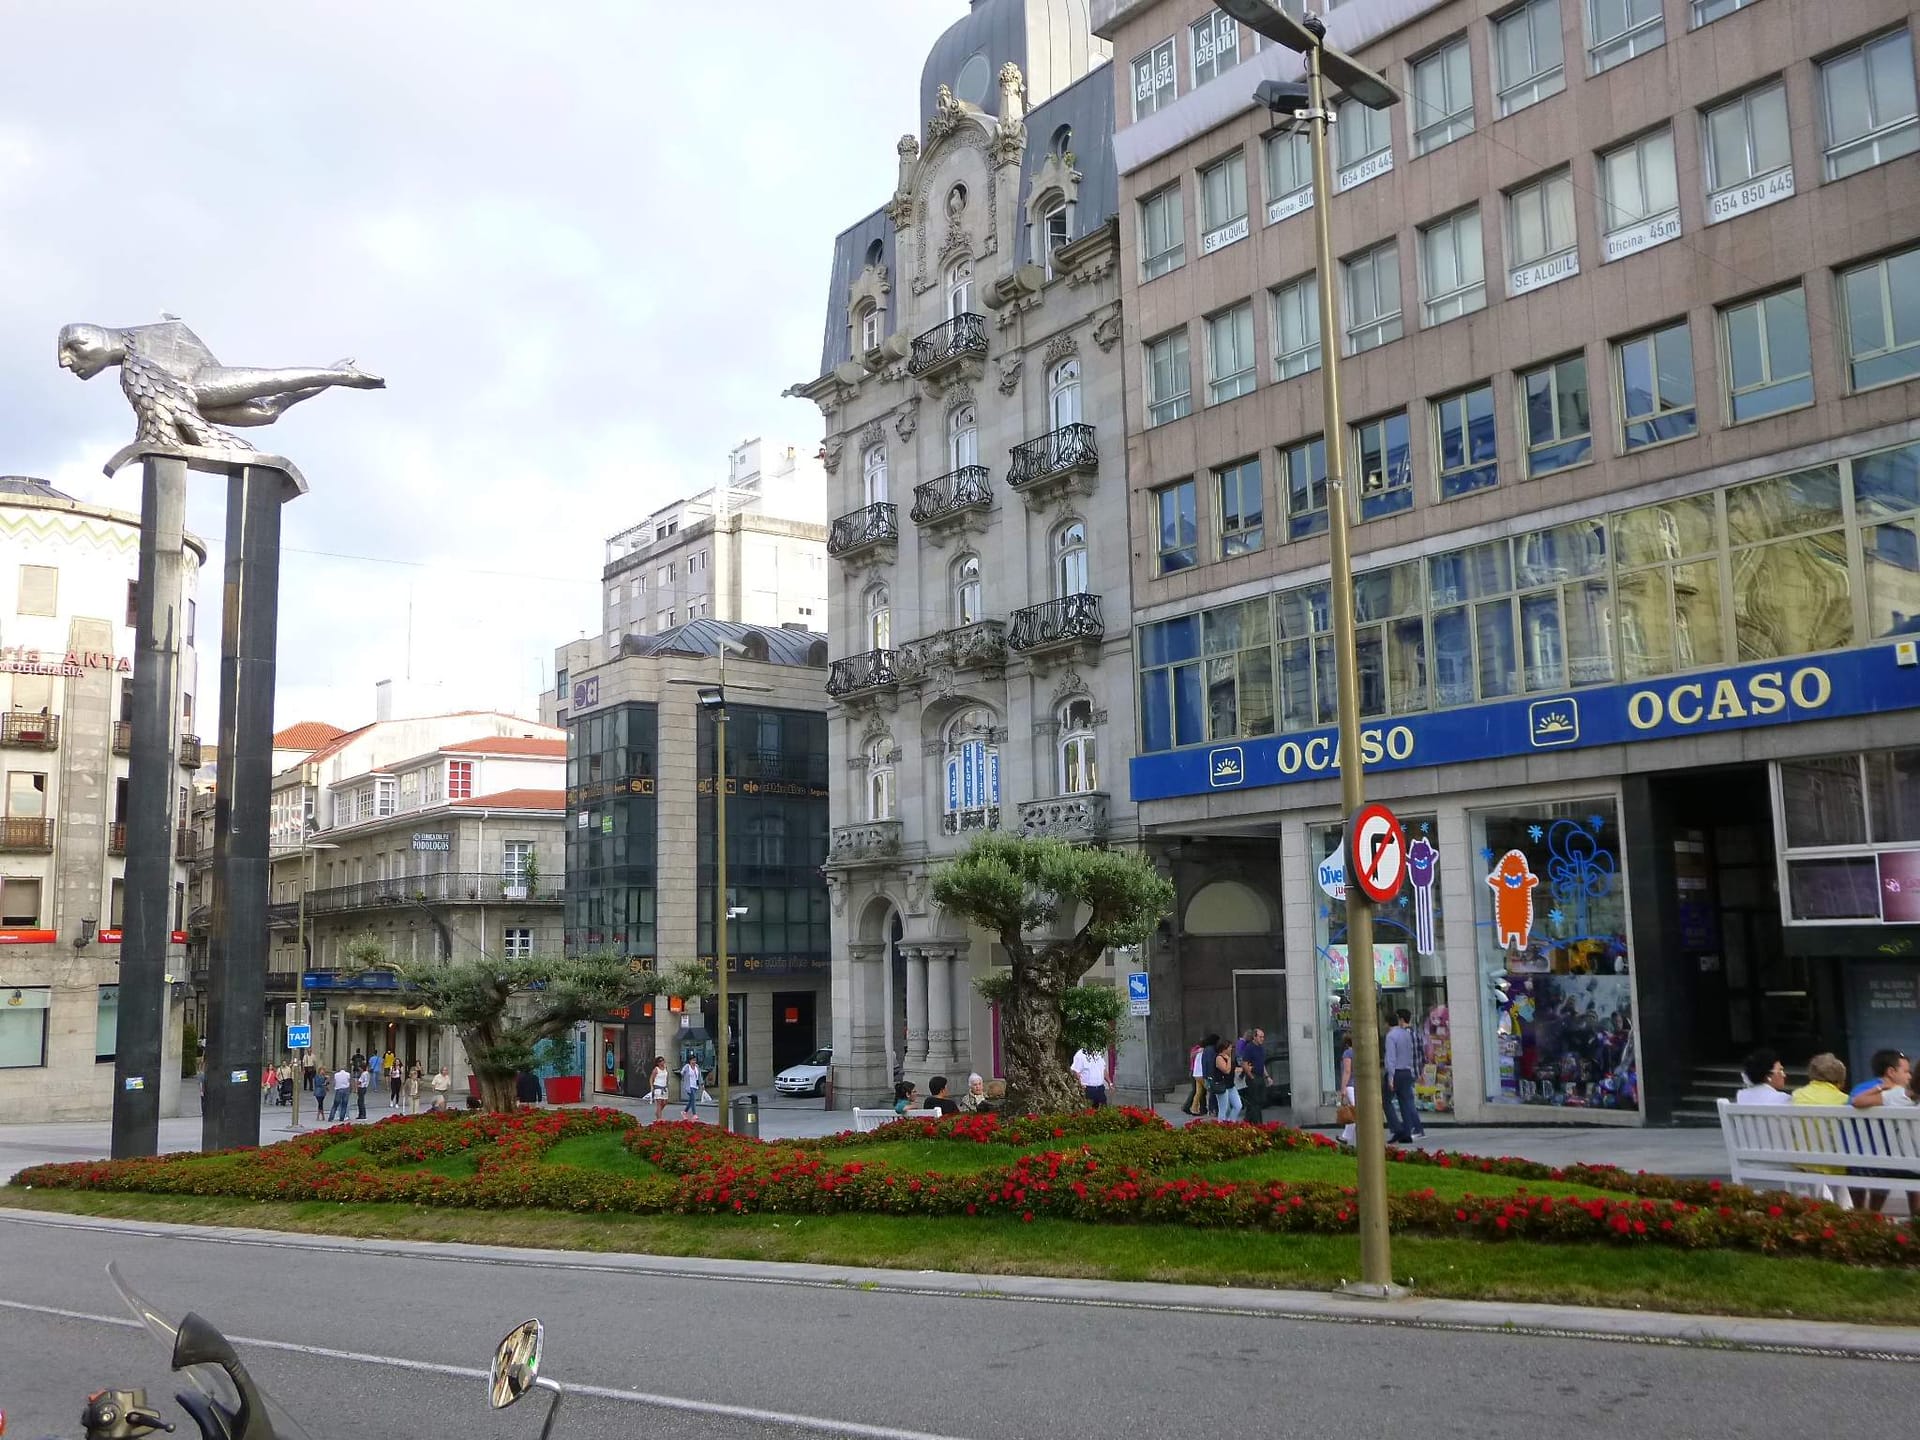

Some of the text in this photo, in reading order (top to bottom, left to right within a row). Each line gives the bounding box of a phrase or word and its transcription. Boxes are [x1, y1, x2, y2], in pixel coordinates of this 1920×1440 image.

[1714, 173, 1792, 214] 654 850 445
[1206, 235, 1216, 249] SE
[1515, 271, 1529, 288] SE
[1628, 666, 1831, 730] OCASO
[1277, 725, 1414, 774] OCSO
[412, 840, 449, 850] PODOLOGOS
[289, 1032, 309, 1041] TAXI
